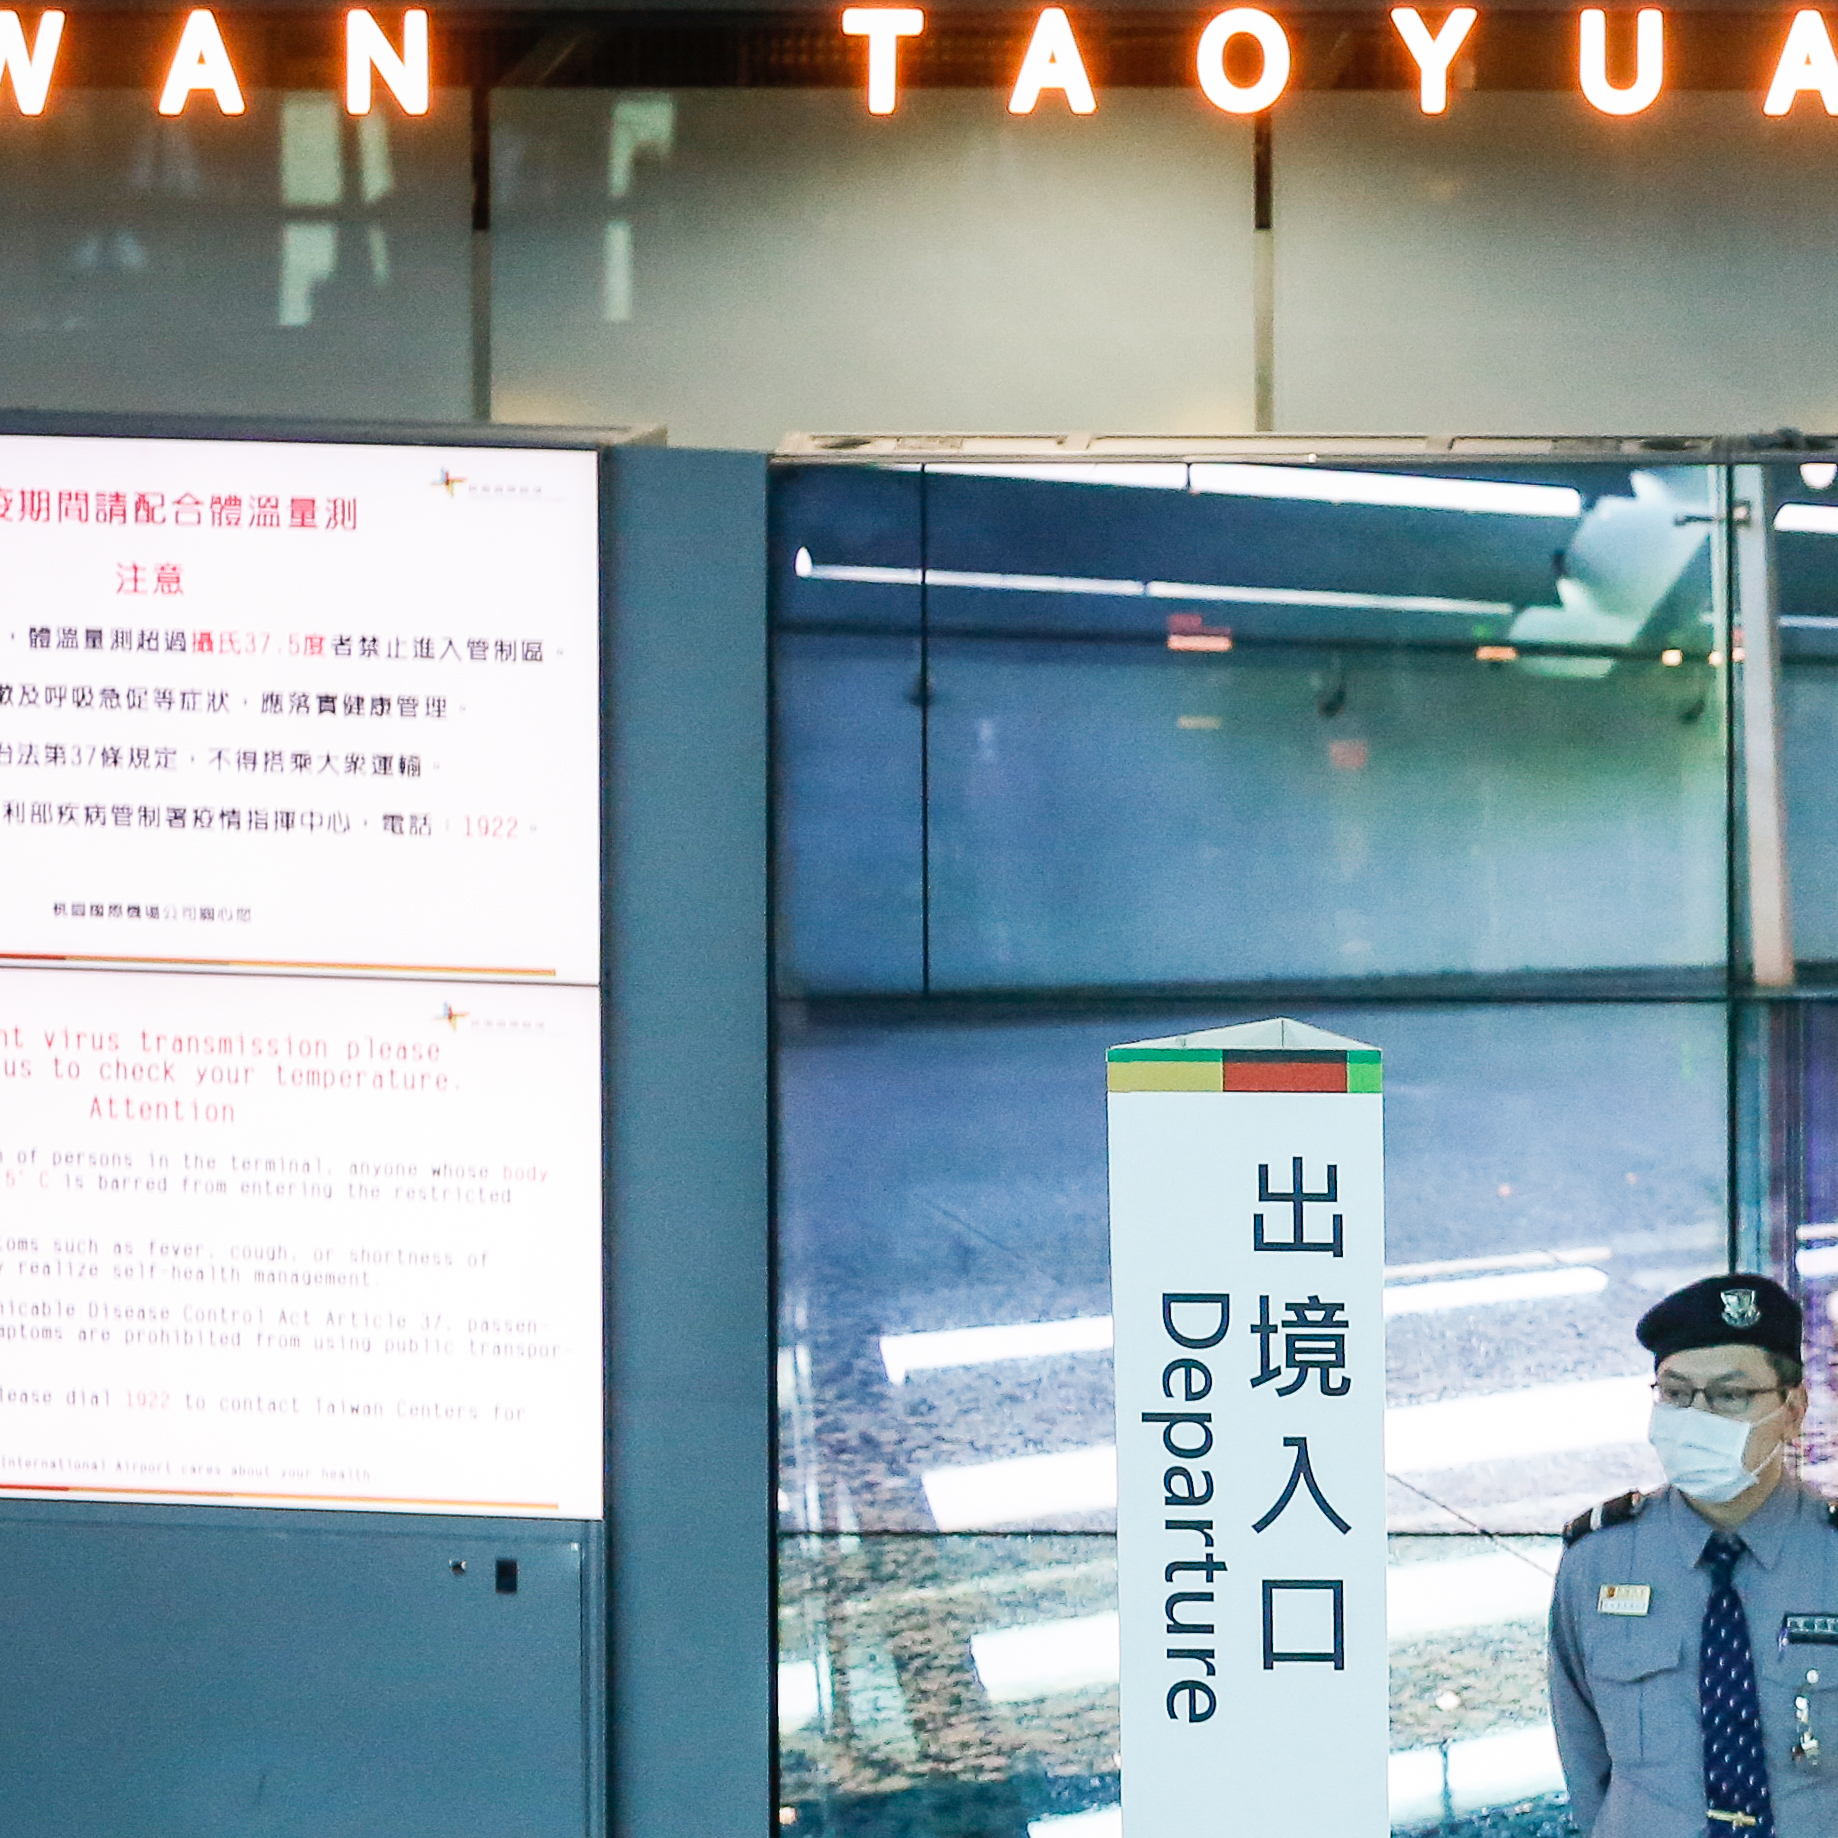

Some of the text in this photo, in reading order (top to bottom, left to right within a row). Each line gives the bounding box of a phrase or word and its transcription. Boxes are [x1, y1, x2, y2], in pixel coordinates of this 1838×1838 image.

[115, 561, 185, 596] 注意
[43, 1030, 441, 1062] virus transmission please
[3, 1057, 461, 1092] us to check your temperature.
[88, 1094, 236, 1124] Attention
[1250, 1156, 1352, 1671] 出境入口
[1141, 1292, 1230, 1724] Departure
